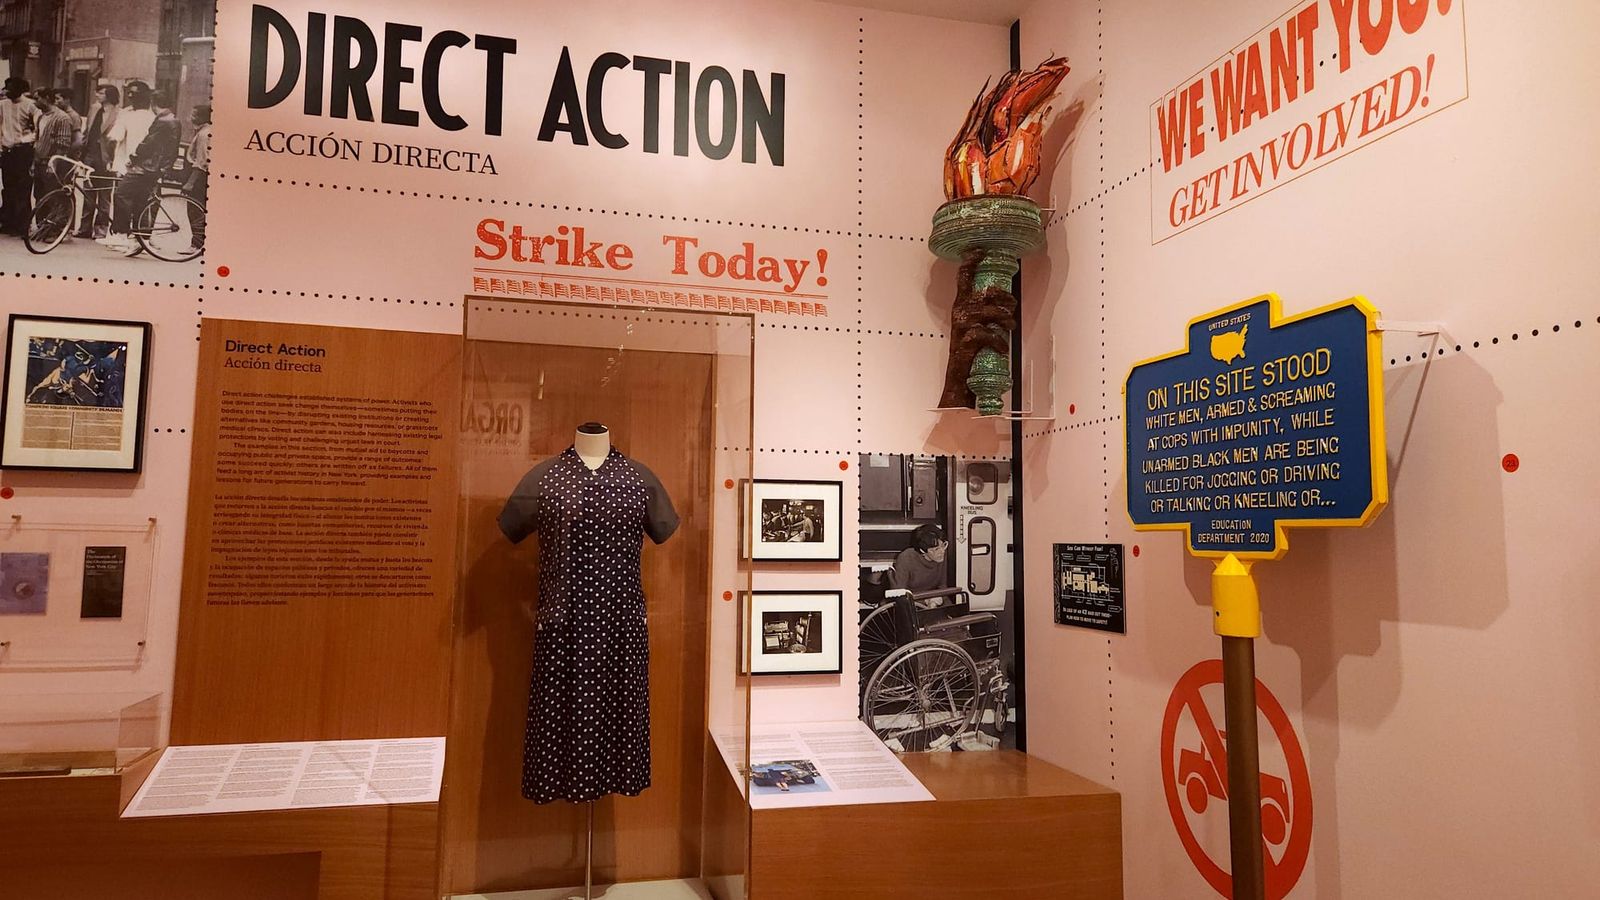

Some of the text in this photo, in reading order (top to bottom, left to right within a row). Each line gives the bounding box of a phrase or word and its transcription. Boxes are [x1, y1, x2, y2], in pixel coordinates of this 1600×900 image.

[247, 4, 786, 167] DIRECT ACTION
[1157, 78, 1205, 174] WE
[1210, 1, 1319, 142] WANT
[244, 129, 499, 176] ACCIÓN DIRECTA
[1170, 54, 1435, 228] GET INVOLVED!
[474, 218, 829, 293] Strike Today!
[1208, 313, 1251, 331] UNITED STATES
[224, 356, 322, 373] Acción directa
[225, 339, 325, 357] Direct Action
[1147, 348, 1331, 411] ON THIS SITE STOOD
[1145, 382, 1336, 430] WHITE MEN, ARMED & SCREAMING
[1147, 408, 1335, 452] AT COPS WITH IMPUNITY, WHILE
[1142, 437, 1340, 474] UNARMED BLACK MEN ARE BEING
[1145, 462, 1340, 494] KILLED FOR JOGGING OR DRIVING
[1150, 497, 1164, 513] OR
[1166, 495, 1211, 512] TALKING
[1214, 494, 1231, 510] OR
[1234, 490, 1297, 509] KNEELING
[1197, 532, 1270, 544] DEPARTMENT 2020
[1211, 519, 1252, 530] EDUCATION
